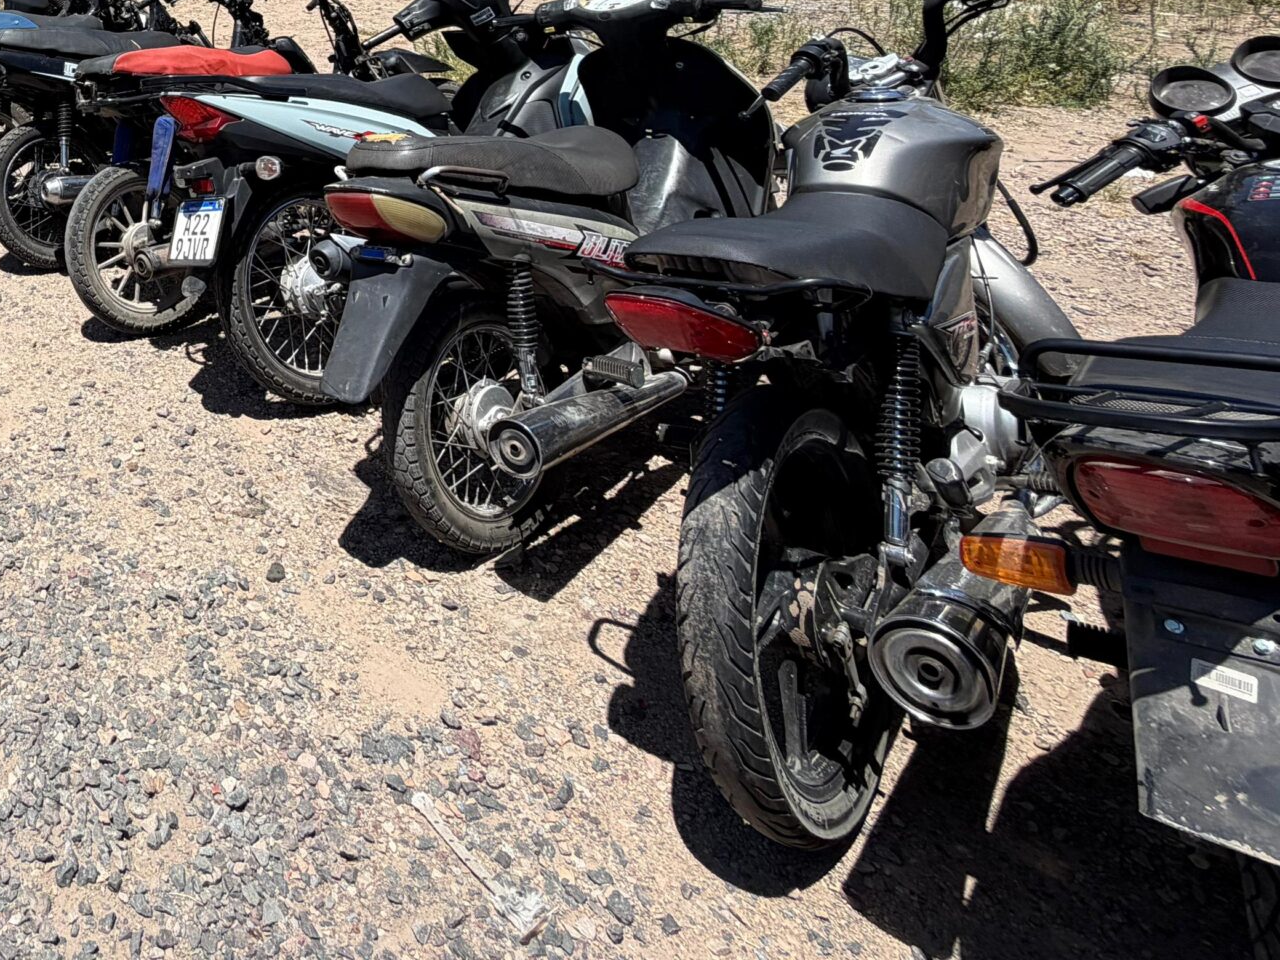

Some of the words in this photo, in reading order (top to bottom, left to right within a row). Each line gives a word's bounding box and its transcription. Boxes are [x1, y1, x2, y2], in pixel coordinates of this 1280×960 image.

[182, 213, 211, 236] A22
[175, 237, 210, 260] 9JVR
[577, 230, 632, 263] BLIT
